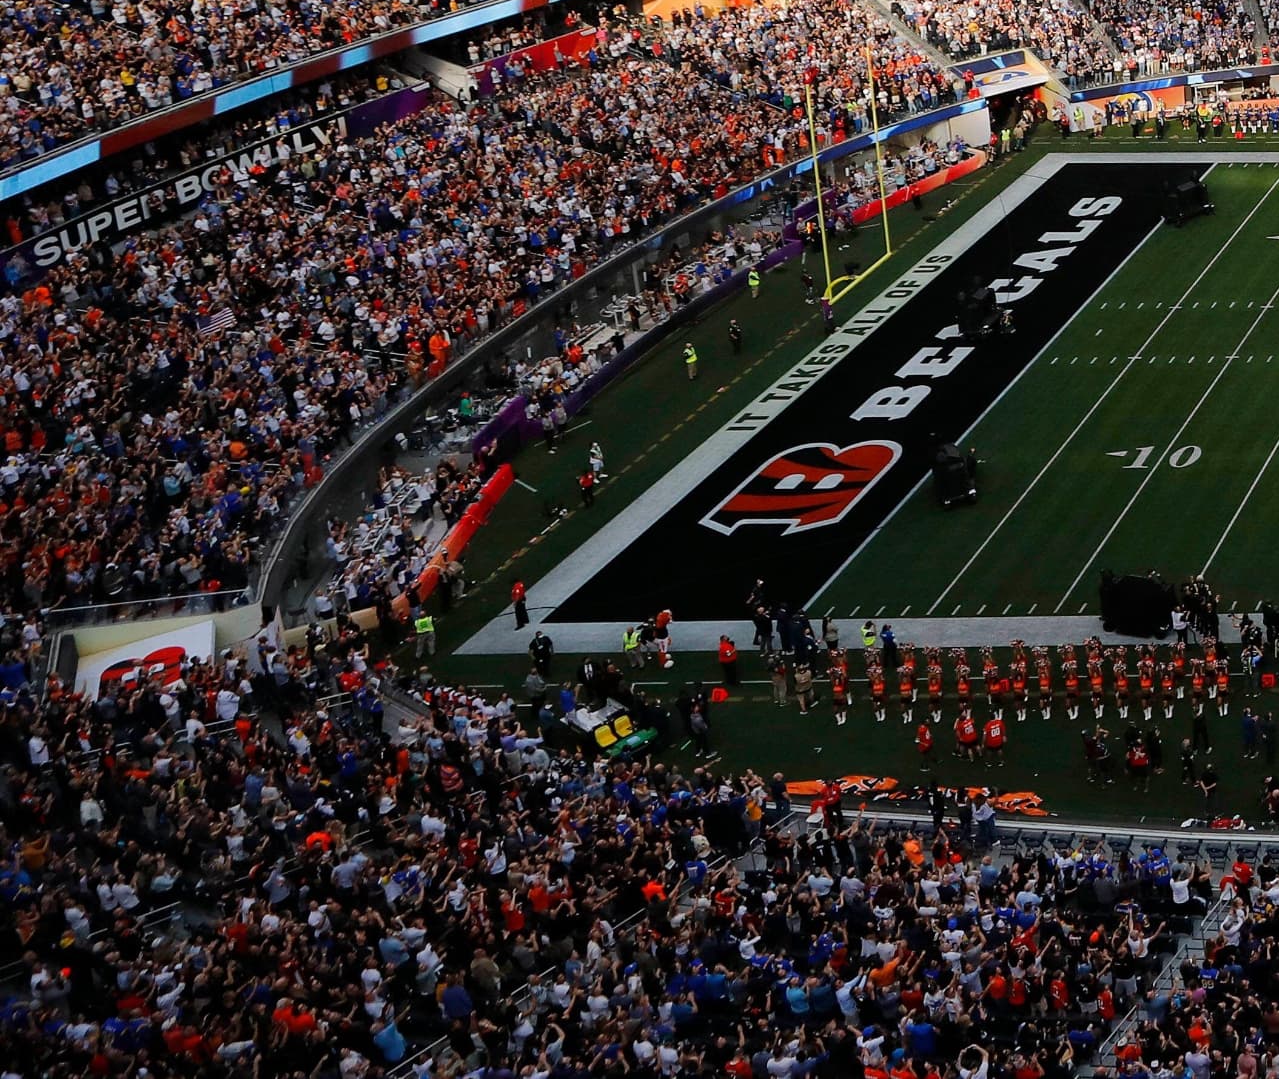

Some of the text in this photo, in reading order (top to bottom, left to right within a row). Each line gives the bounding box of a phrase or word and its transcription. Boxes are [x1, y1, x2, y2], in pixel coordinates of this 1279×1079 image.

[726, 254, 953, 432] IT TAKES ALL OF US
[849, 195, 1123, 421] BEGALS
[1122, 443, 1203, 470] 10
